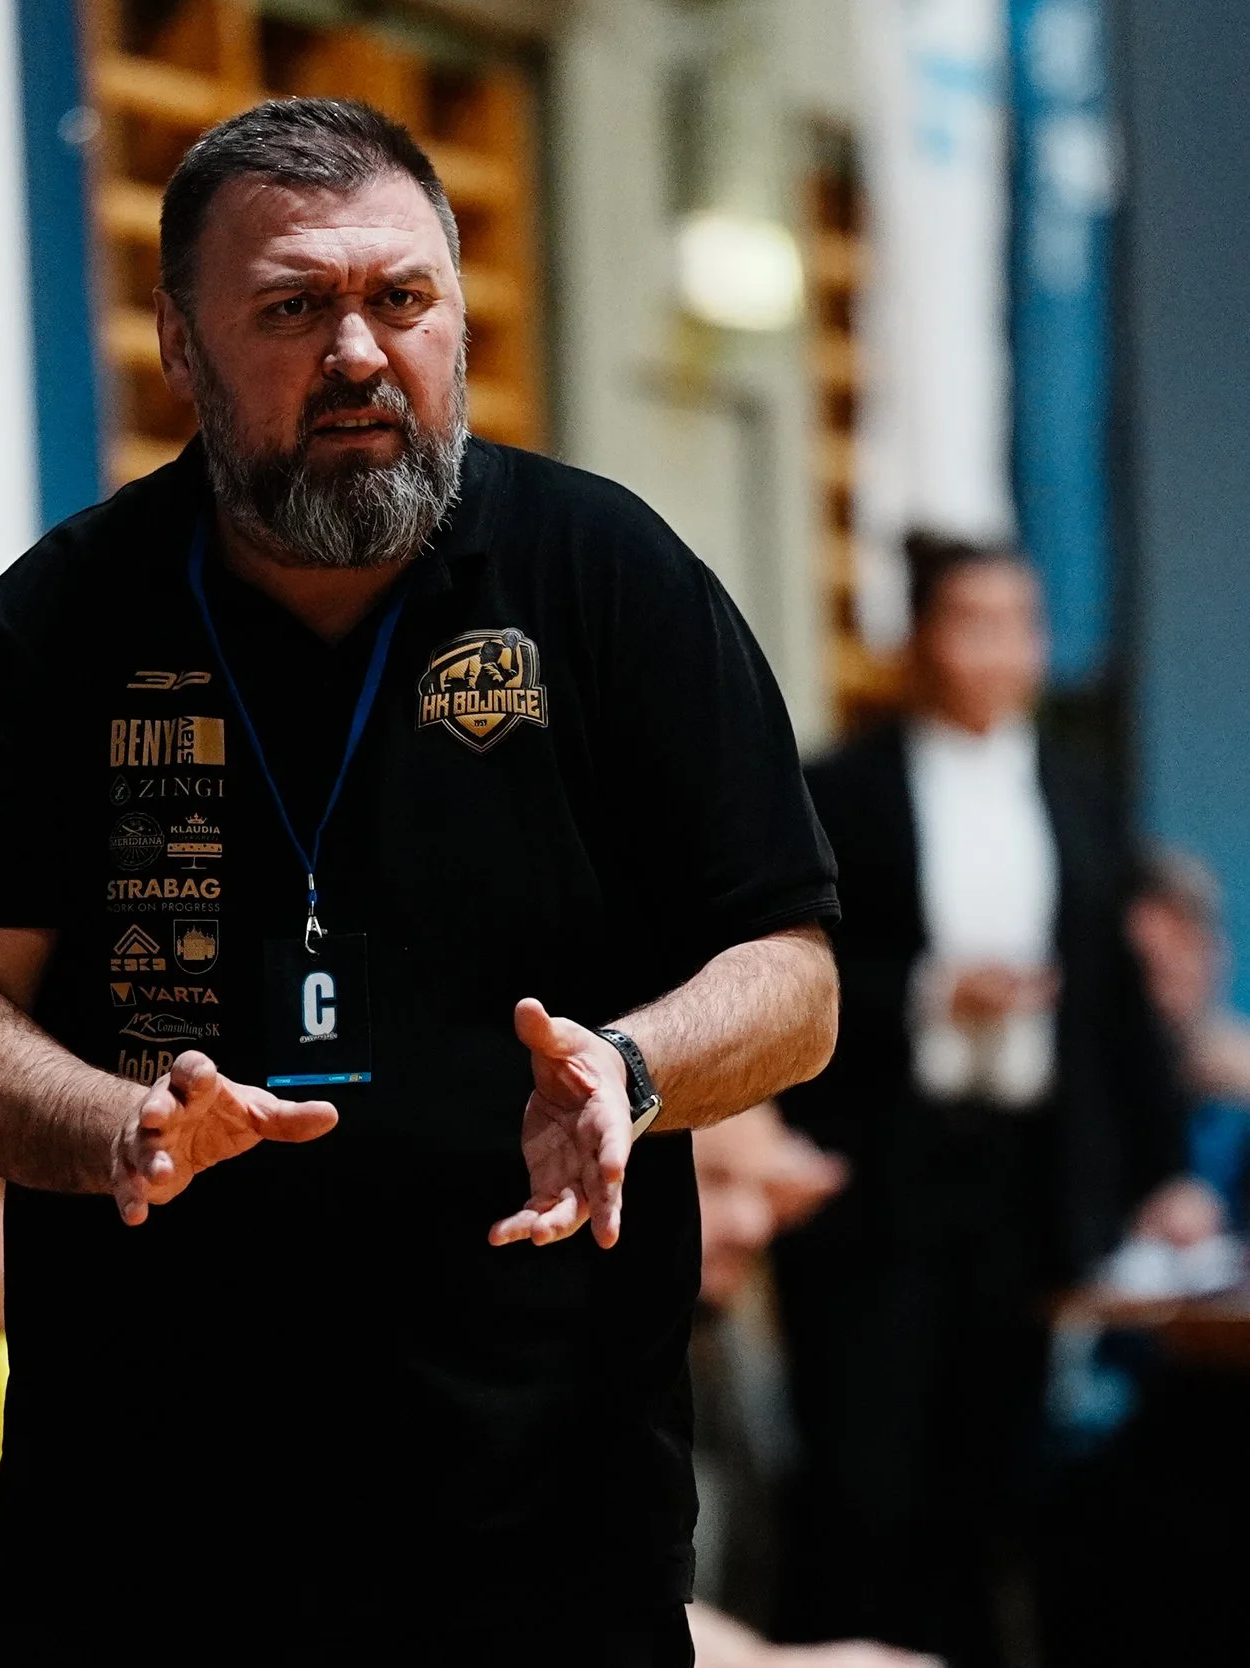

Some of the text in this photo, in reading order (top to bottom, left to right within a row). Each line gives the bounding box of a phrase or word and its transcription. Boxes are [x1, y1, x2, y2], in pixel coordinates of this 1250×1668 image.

[422, 689, 541, 722] HK BOJNICE
[110, 718, 177, 767] BENY
[178, 716, 195, 764] stav
[138, 777, 226, 798] ZINGI
[170, 825, 221, 834] KLAUDIA
[106, 878, 221, 900] STRABAG
[137, 903, 157, 912] ON
[161, 902, 221, 912] PROGRESS
[138, 986, 220, 1004] VARTA
[303, 972, 336, 1035] C
[157, 1019, 203, 1039] Consulting
[205, 1023, 221, 1037] SK
